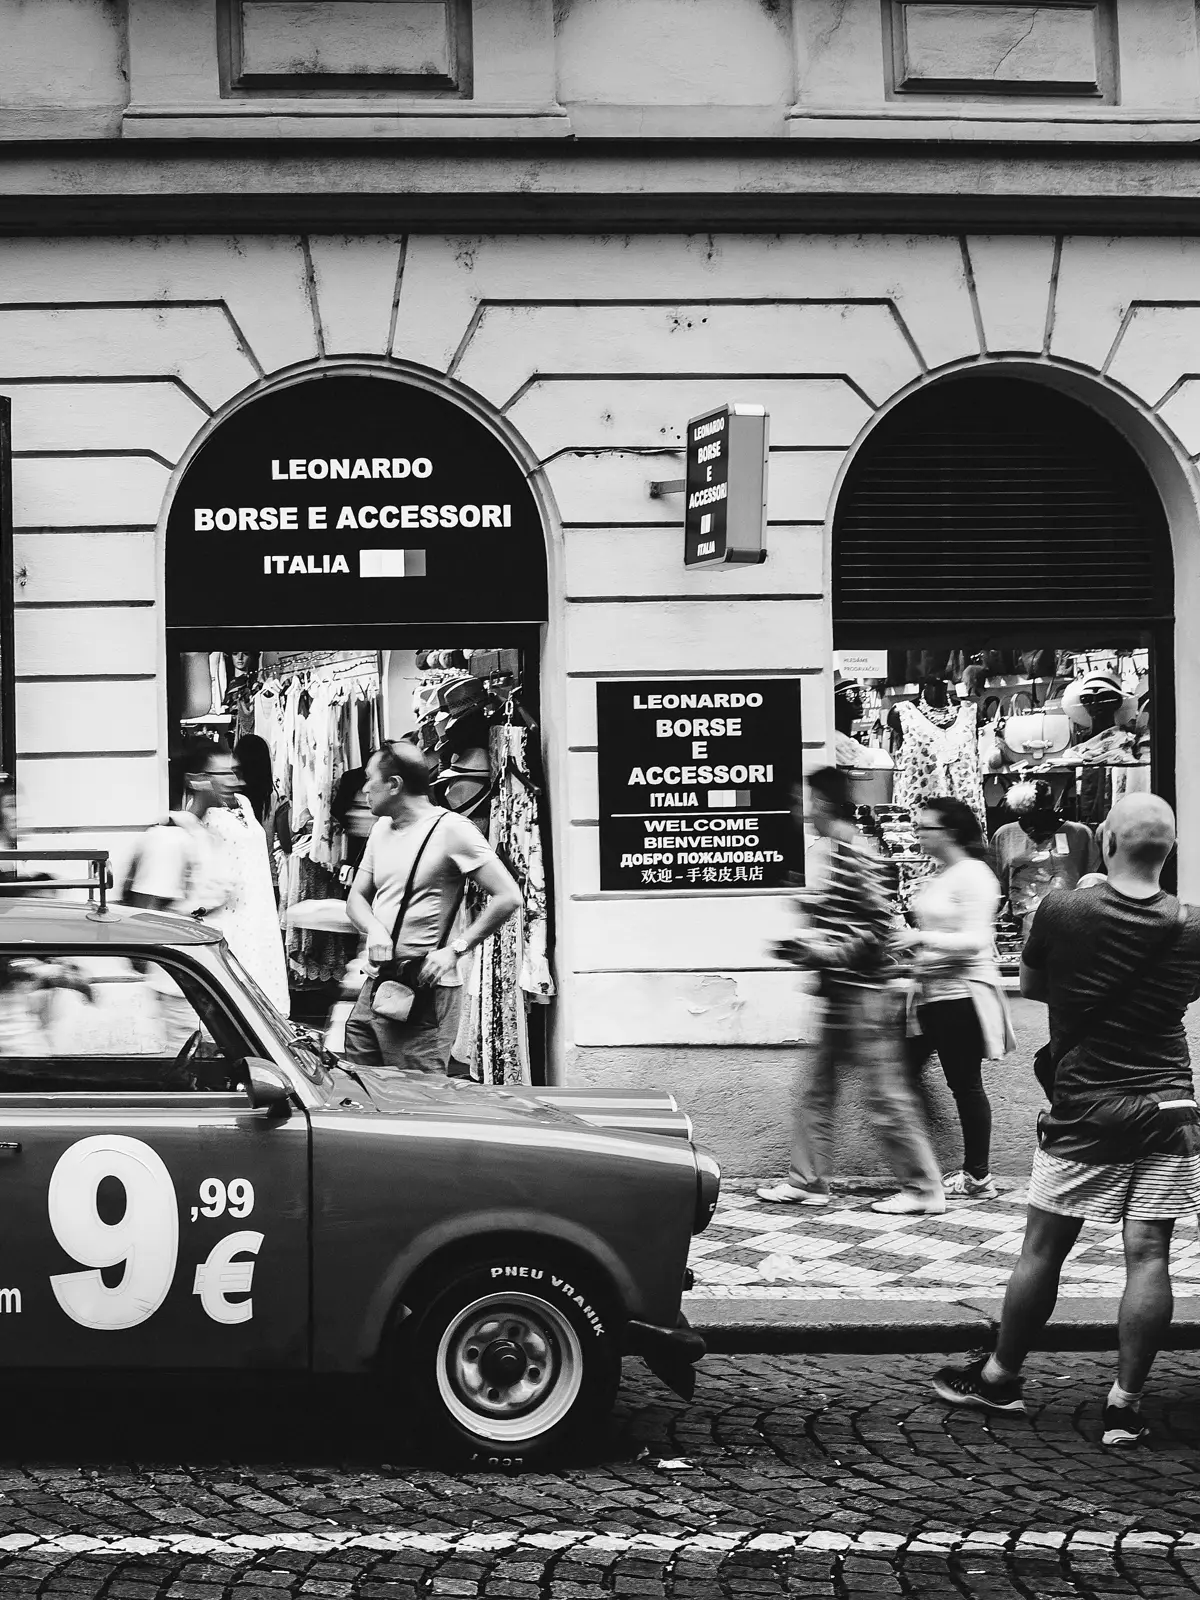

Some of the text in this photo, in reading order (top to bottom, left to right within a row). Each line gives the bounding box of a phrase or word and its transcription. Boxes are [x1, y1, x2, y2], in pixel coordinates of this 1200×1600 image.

[694, 416, 725, 441] LEONARDO
[697, 440, 721, 464] BORSE
[271, 457, 433, 481] LEONARDO
[706, 466, 713, 483] E
[689, 481, 728, 510] ACCESSORI
[194, 504, 512, 532] BORSE E ACCESSORI
[697, 541, 716, 557] ITALIA
[263, 554, 351, 575] ITALIA
[633, 692, 764, 710] LEONARDO
[656, 717, 742, 738] BORSE
[691, 740, 708, 760] E
[627, 764, 774, 786] ACCESSORI
[649, 791, 699, 808] ITALIA
[643, 818, 759, 832] WELCOME
[643, 834, 760, 848] BIENVENIDO
[620, 850, 784, 868] ДОБРО ПОЖАЛОВАТЬ
[47, 1133, 255, 1331] 9 ,99
[192, 1230, 265, 1325] €
[490, 1266, 605, 1337] PNEU VRANIK
